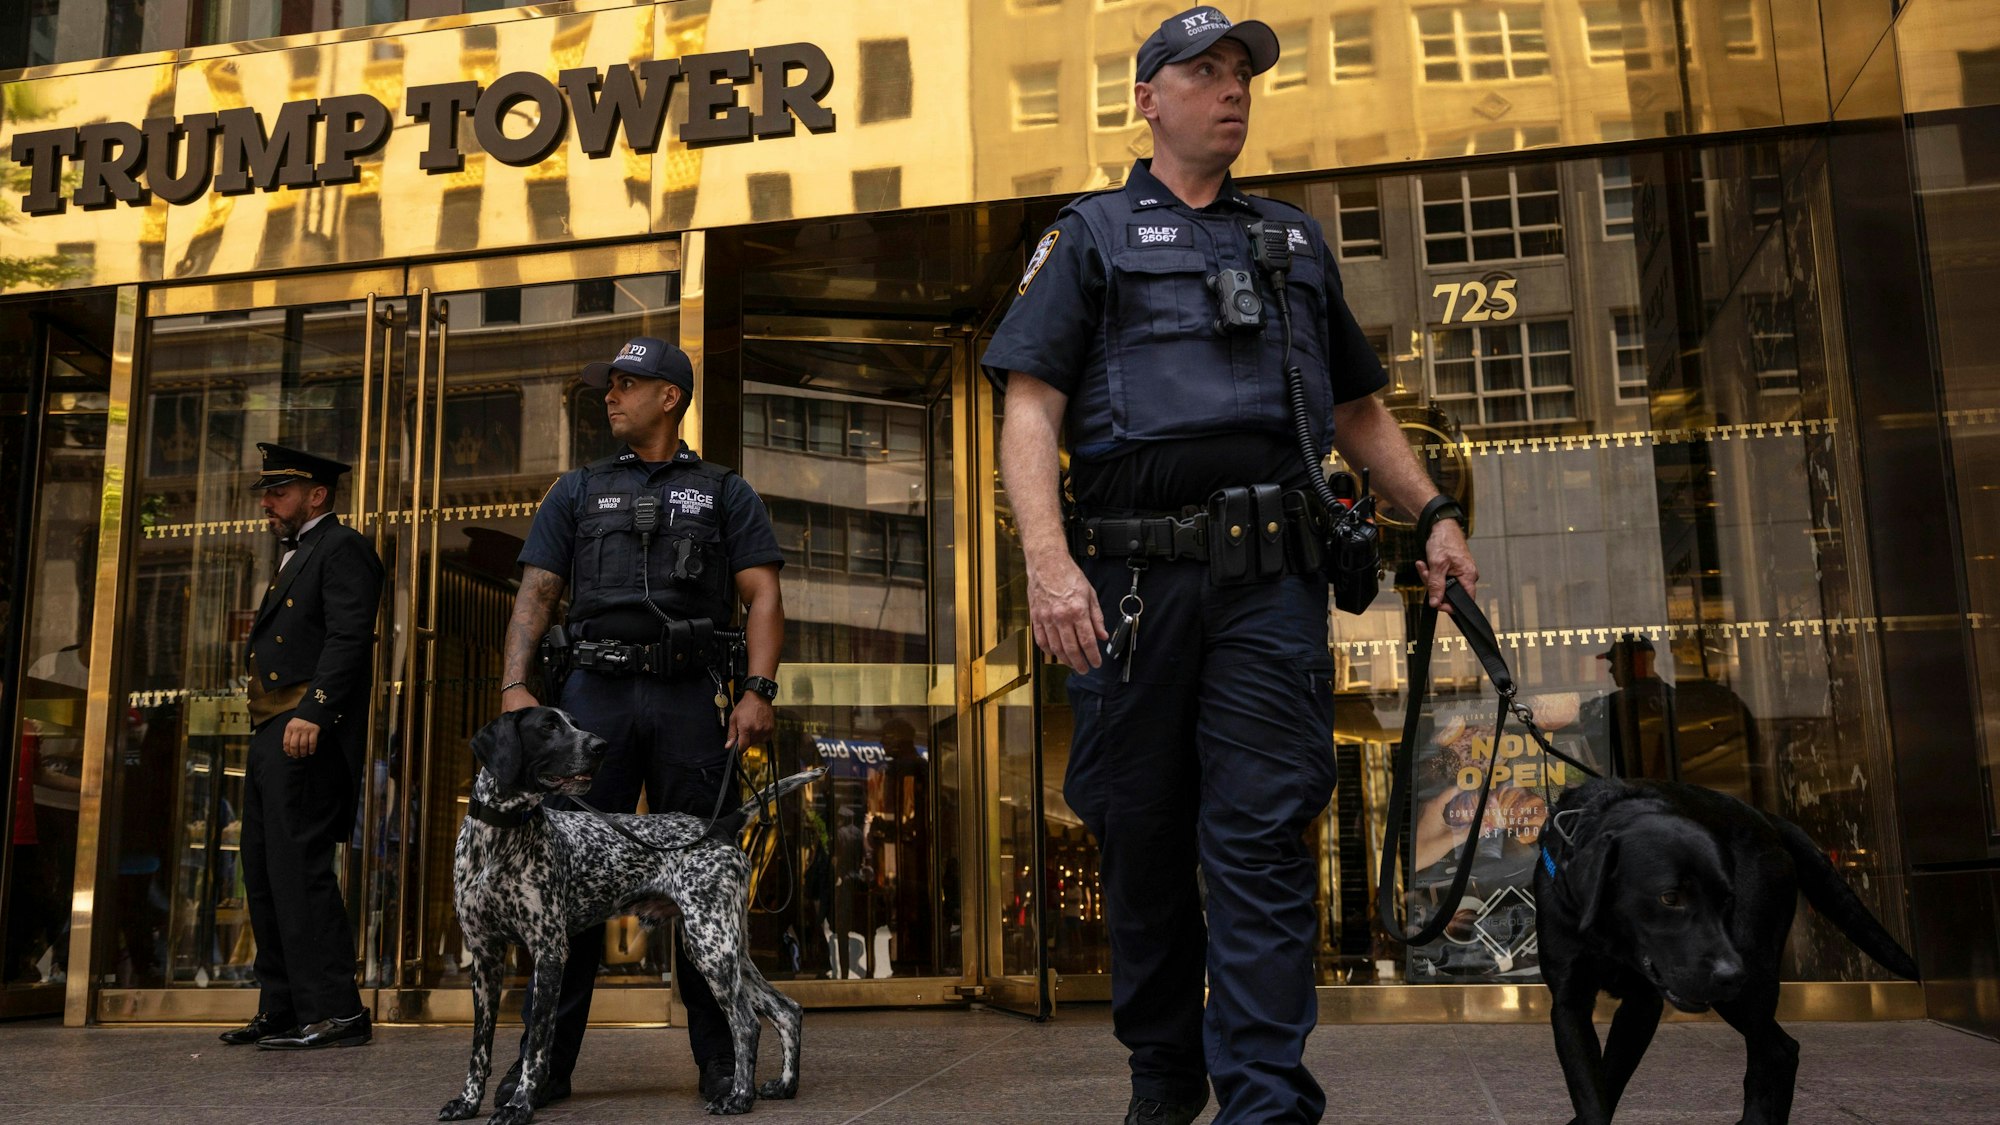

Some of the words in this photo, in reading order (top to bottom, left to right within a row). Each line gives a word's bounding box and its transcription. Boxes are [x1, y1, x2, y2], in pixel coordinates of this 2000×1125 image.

[11, 93, 392, 216] TRUMP
[406, 41, 837, 176] TOWER
[1138, 226, 1178, 236] DALEY
[1141, 235, 1177, 243] 25067
[1432, 279, 1518, 325] 725
[597, 497, 621, 505] MATOS
[670, 490, 714, 505] POLICE
[1471, 732, 1554, 760] NOW
[1456, 761, 1566, 791] OPEN
[1449, 808, 1475, 818] COME
[1482, 806, 1514, 817] NSIDE
[1520, 806, 1538, 815] THE
[1507, 826, 1539, 838] FLOO
